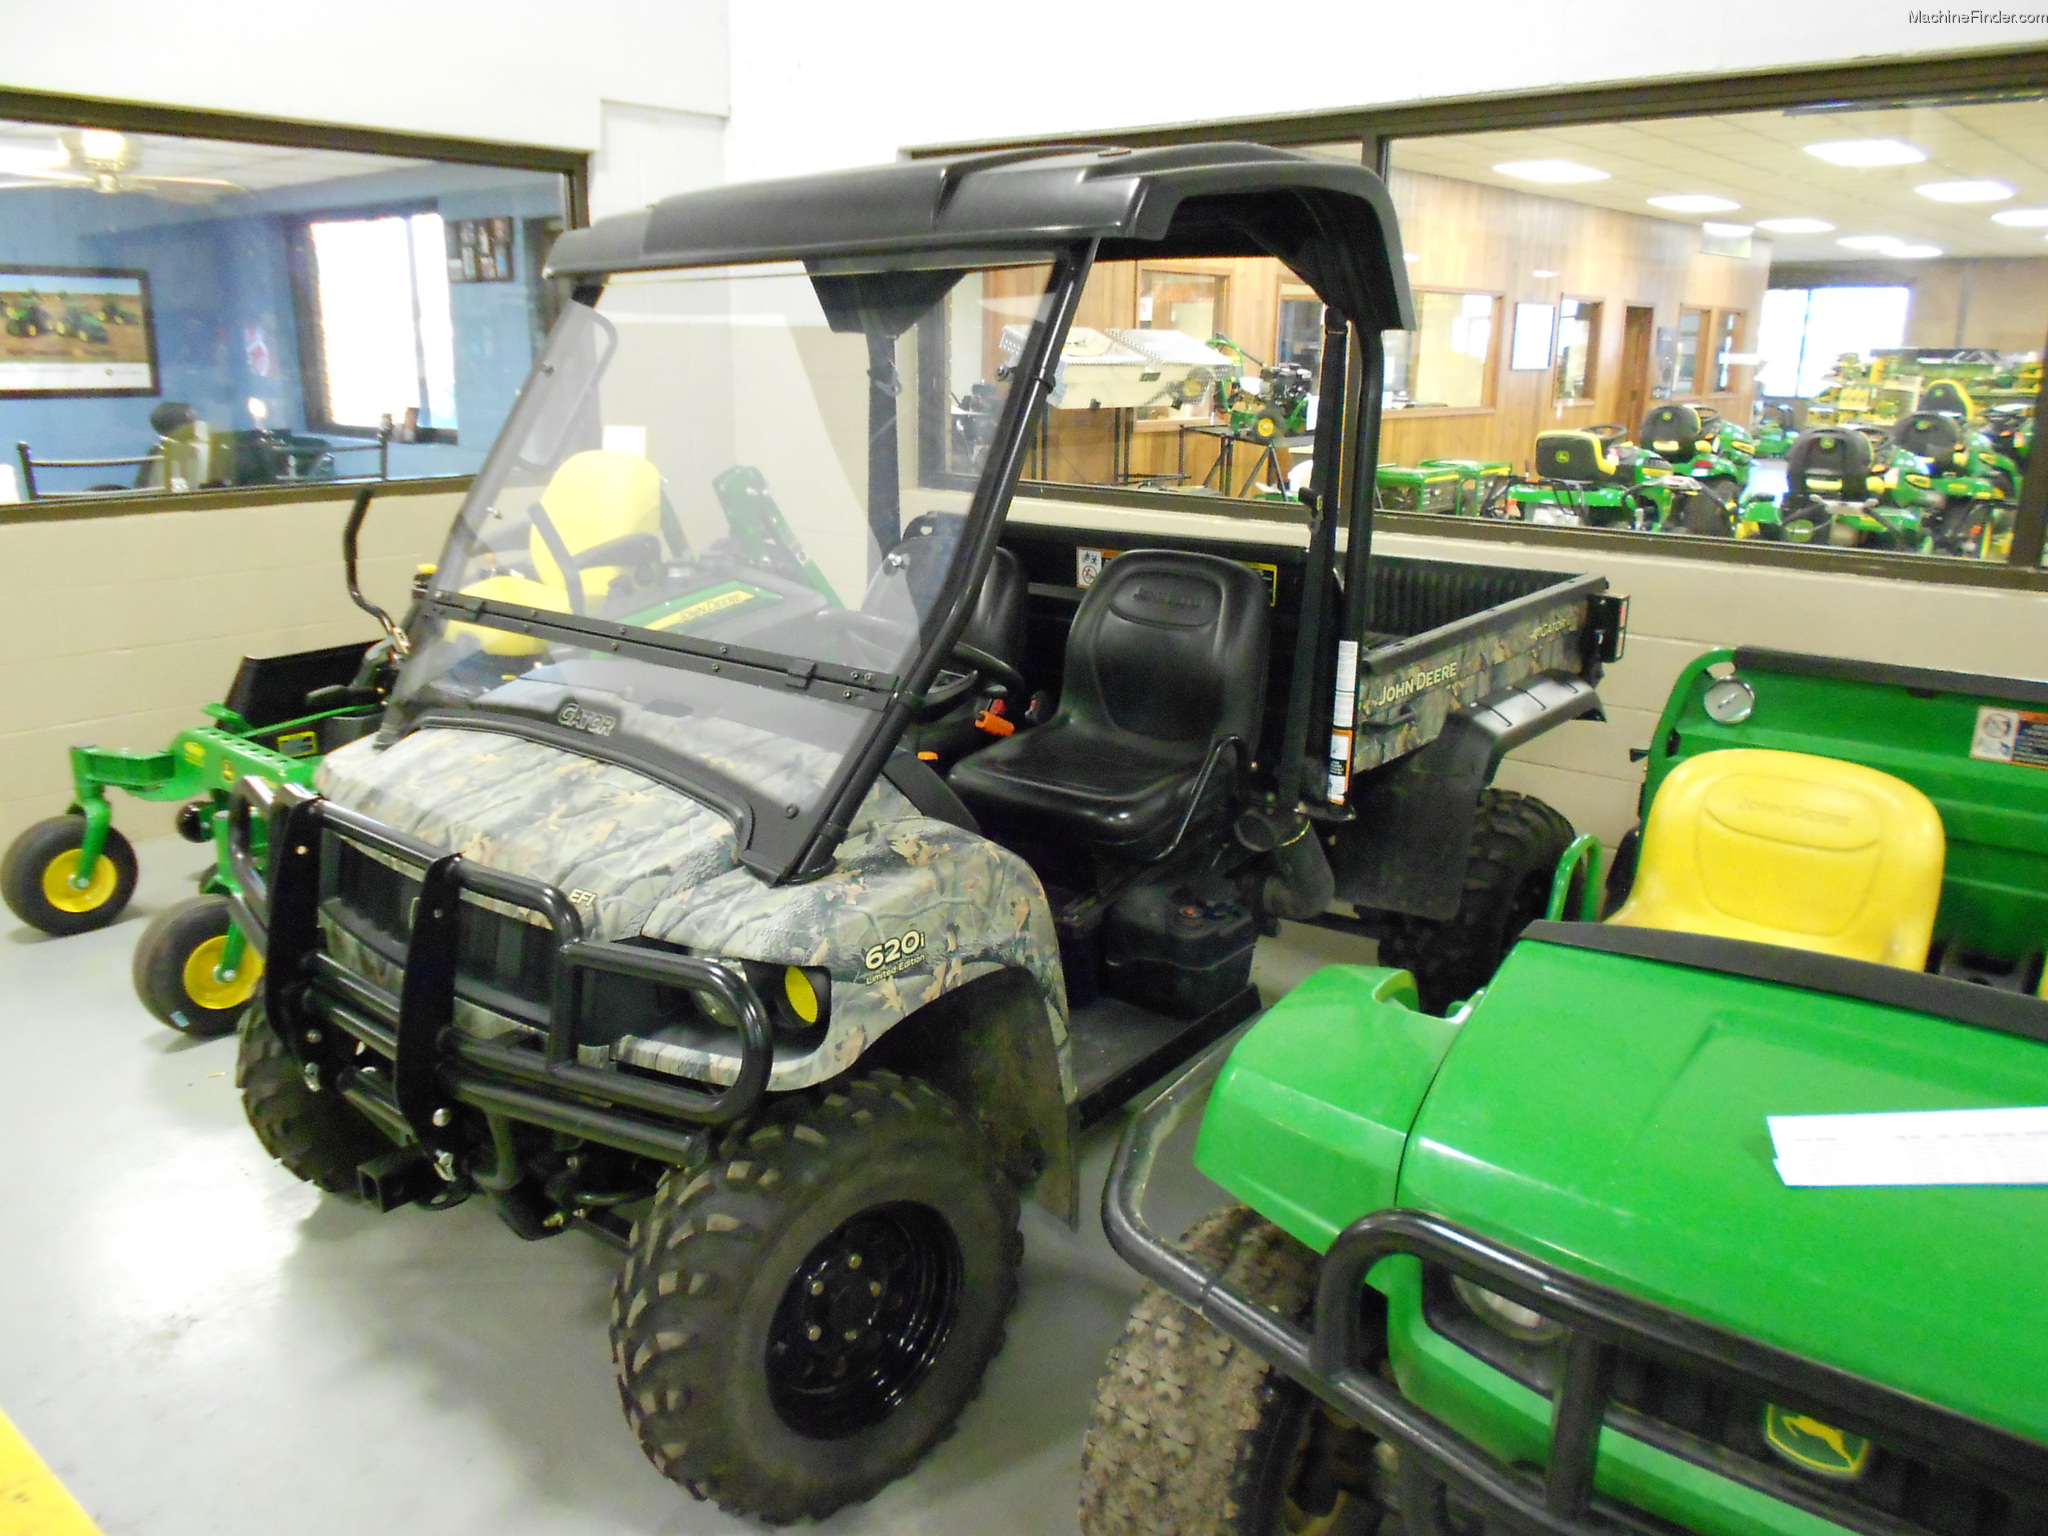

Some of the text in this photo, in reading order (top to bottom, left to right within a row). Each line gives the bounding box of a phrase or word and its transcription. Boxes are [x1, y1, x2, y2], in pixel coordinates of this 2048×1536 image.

[680, 593, 741, 623] JOHN DEERE
[1379, 662, 1458, 706] JOHN DEERE
[558, 702, 616, 737] GATOR
[568, 887, 597, 907] EFI
[865, 929, 926, 971] 620i
[865, 953, 926, 986] Limited Edition
